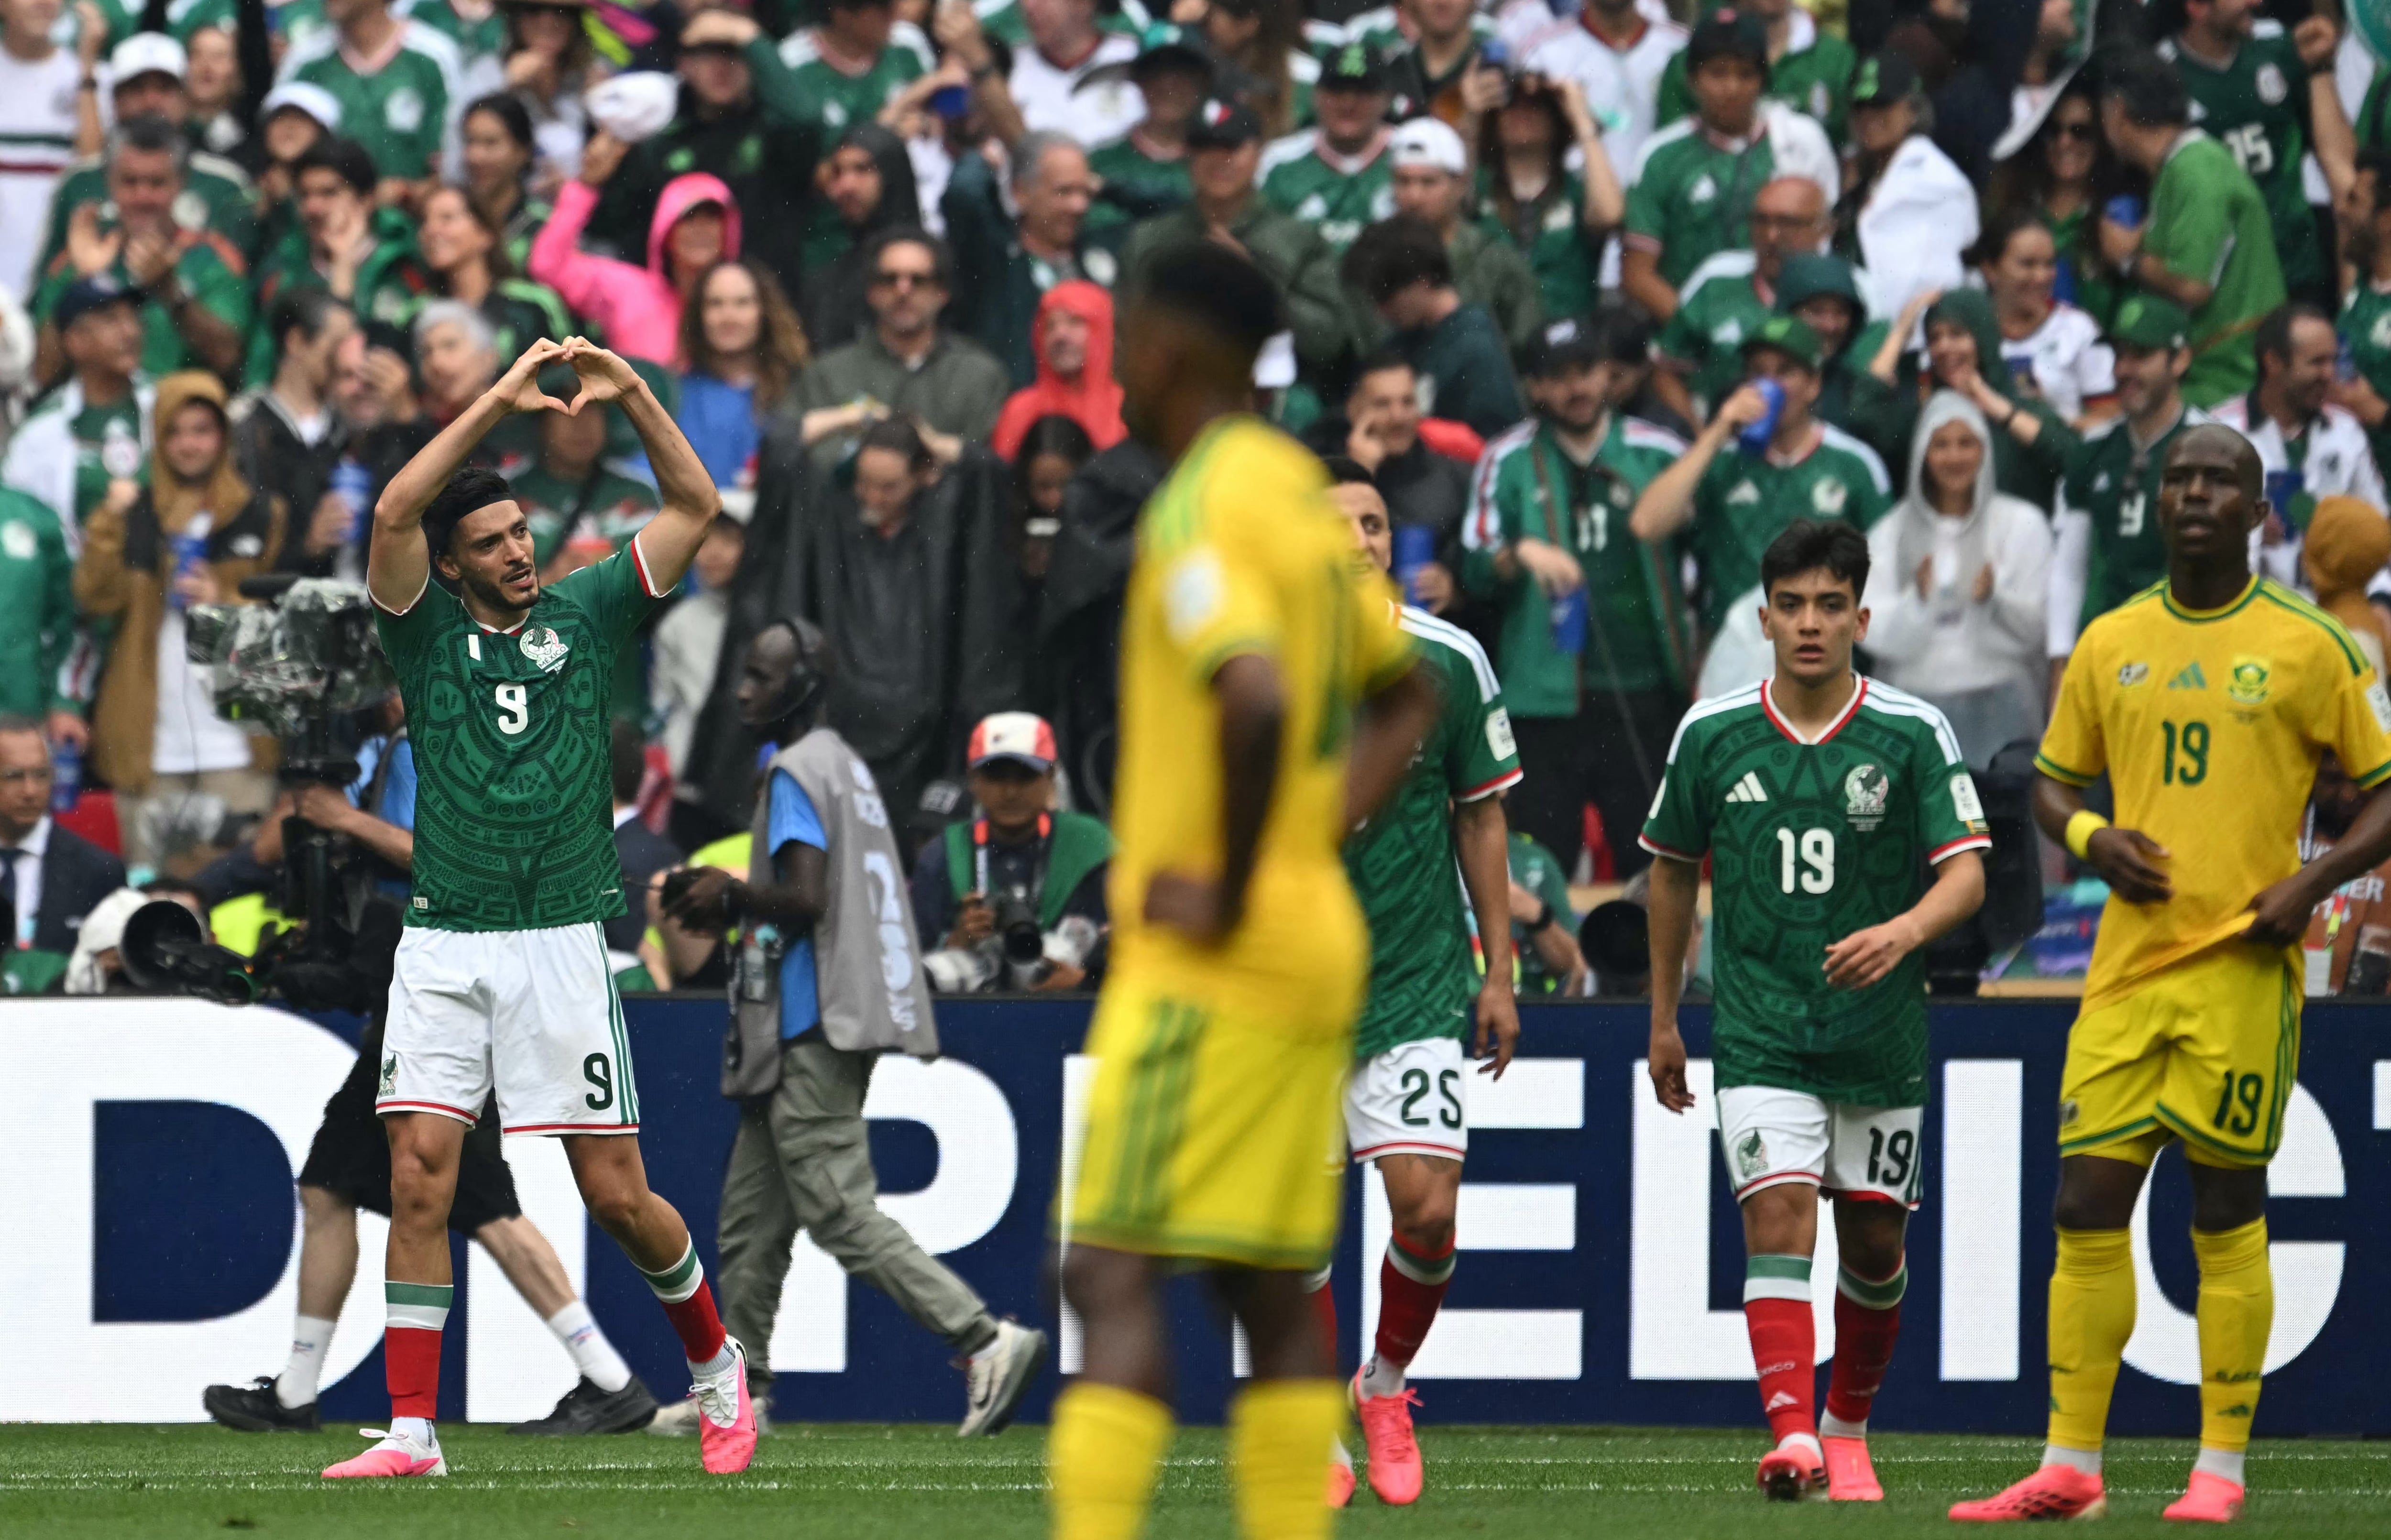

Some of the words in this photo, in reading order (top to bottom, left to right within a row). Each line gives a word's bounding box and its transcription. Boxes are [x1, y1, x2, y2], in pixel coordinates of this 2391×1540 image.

[2224, 122, 2273, 174] 15
[1577, 503, 1607, 552] 11
[538, 646, 566, 667] MÉXICO
[495, 680, 528, 734] 9
[2162, 721, 2210, 786] 19
[1777, 827, 1835, 894] 19
[583, 1052, 613, 1111] 9
[1402, 1068, 1461, 1129] 25
[2214, 1071, 2264, 1138] 19
[1867, 1127, 1913, 1187] 19
